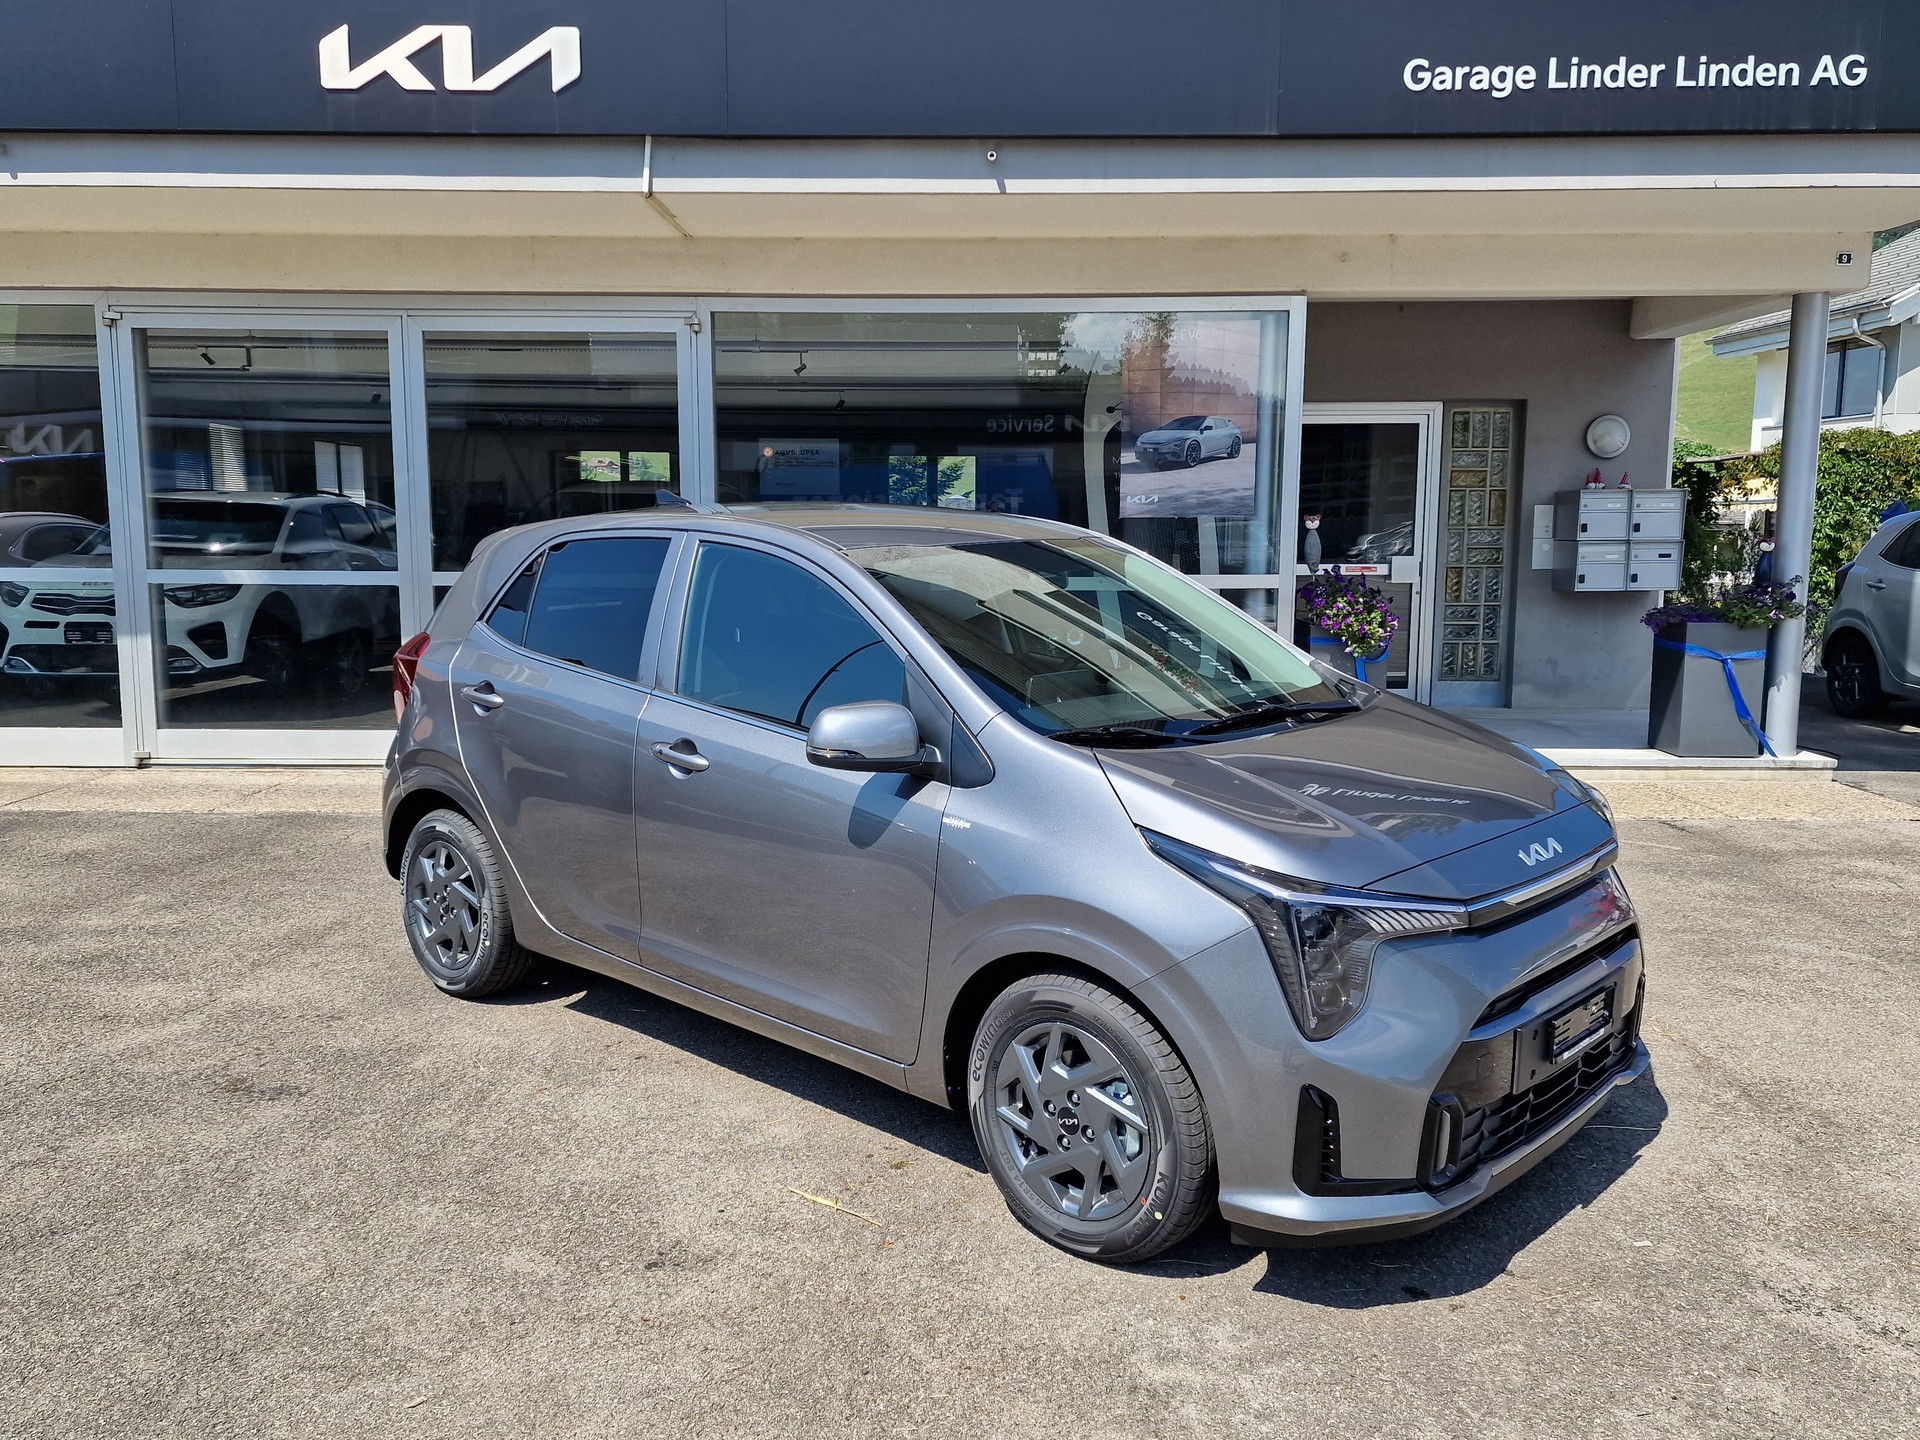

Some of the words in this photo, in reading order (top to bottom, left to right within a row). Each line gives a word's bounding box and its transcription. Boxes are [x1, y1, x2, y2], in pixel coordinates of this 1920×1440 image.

[318, 23, 582, 94] KIA
[1403, 57, 1537, 99] Garage
[1547, 56, 1666, 90] Linder
[1676, 54, 1800, 88] Linden
[1809, 54, 1869, 88] AG
[1841, 254, 1848, 263] 9
[1180, 329, 1202, 340] EV6
[775, 449, 797, 457] AGVS
[1126, 494, 1159, 504] KIA
[1517, 836, 1563, 867] KIA
[1058, 1117, 1078, 1126] KIA
[1130, 1169, 1170, 1236] KUMHO
